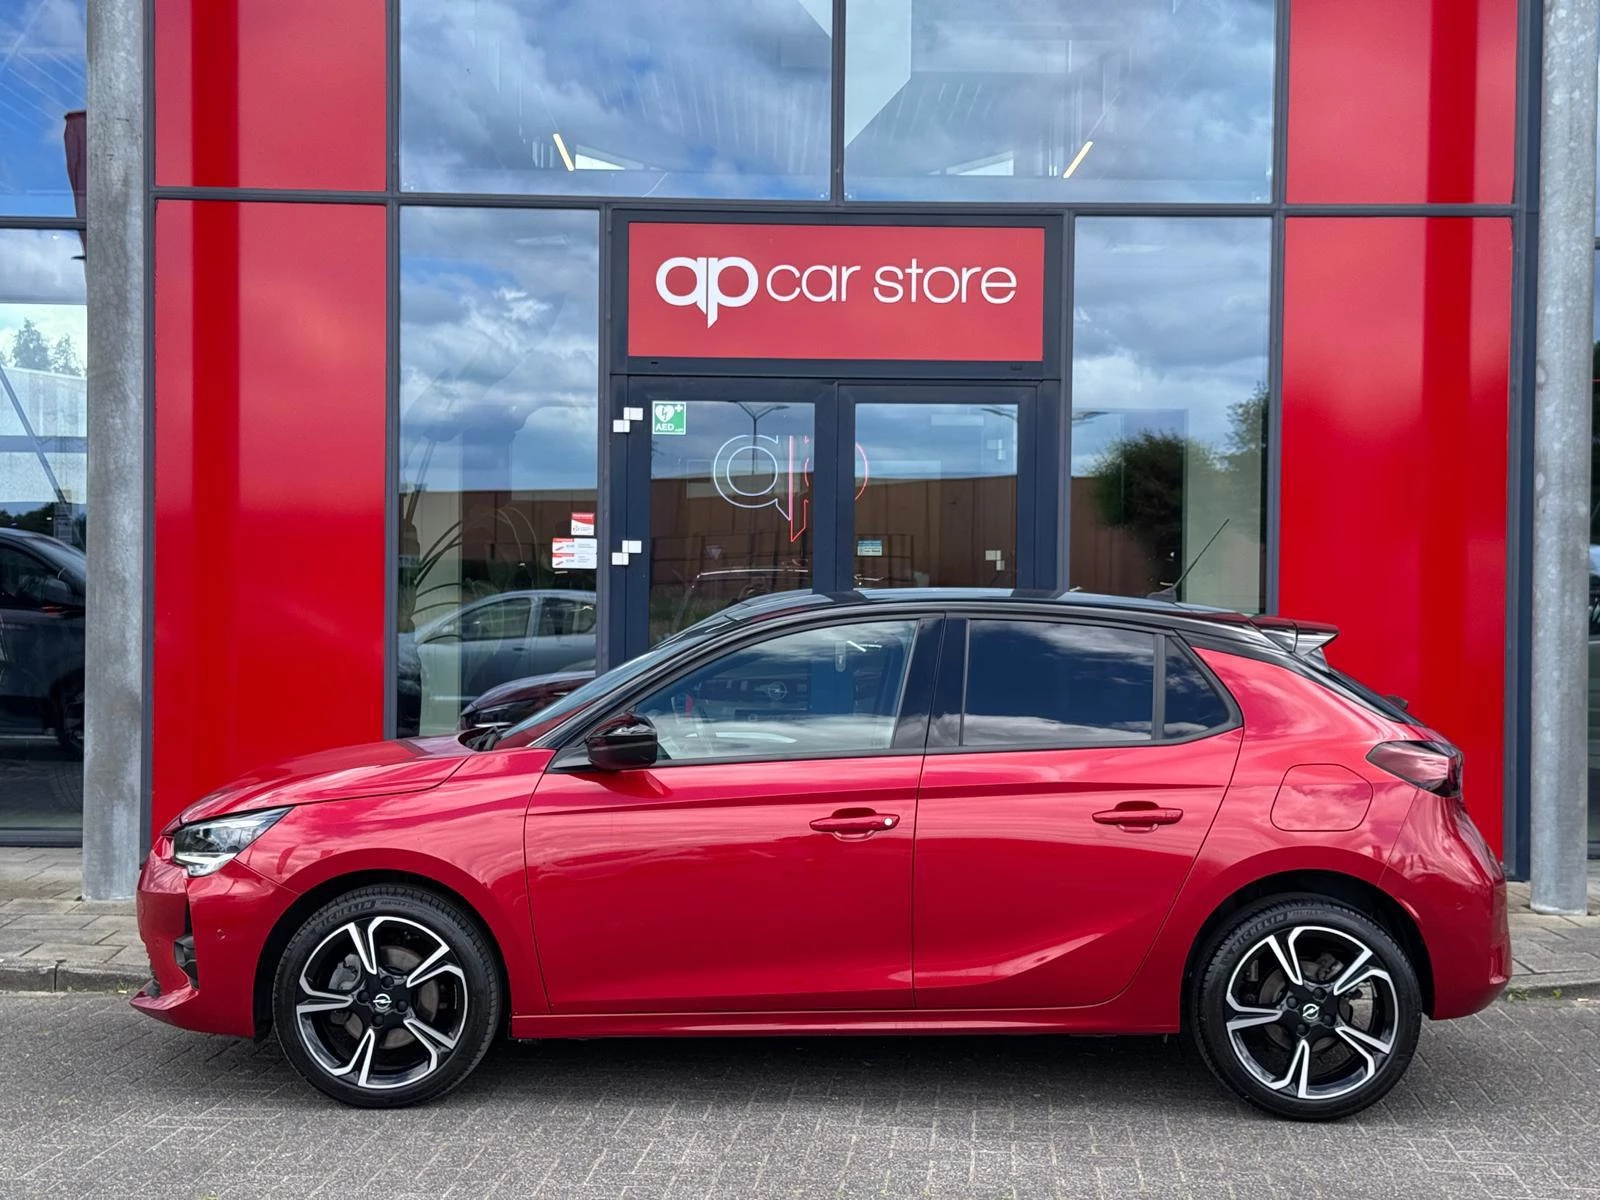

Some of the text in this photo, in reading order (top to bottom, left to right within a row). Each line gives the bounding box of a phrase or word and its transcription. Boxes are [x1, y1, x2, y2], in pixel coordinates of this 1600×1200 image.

[656, 256, 1017, 328] ap car store
[656, 423, 675, 431] AED
[1231, 914, 1285, 952] MICHELIN
